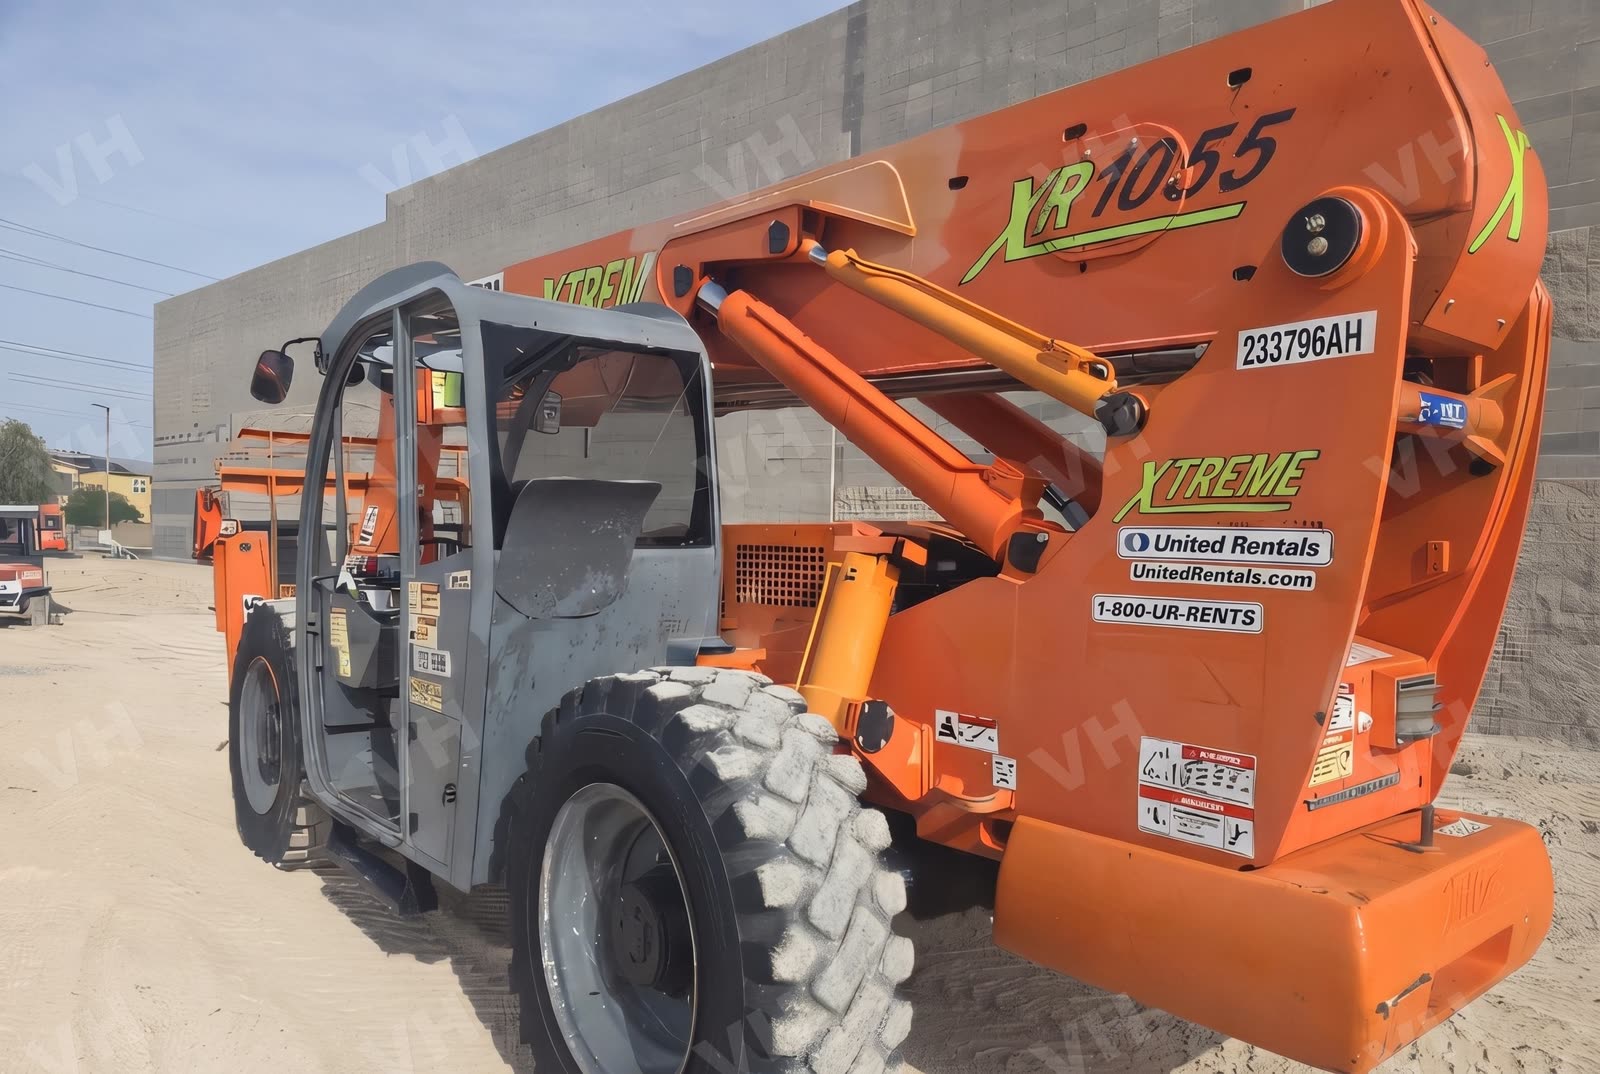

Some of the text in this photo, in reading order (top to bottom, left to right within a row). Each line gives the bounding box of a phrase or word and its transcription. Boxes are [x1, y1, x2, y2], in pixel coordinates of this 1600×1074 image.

[1243, 318, 1362, 366] 233796AH
[1112, 450, 1321, 524] XTREME
[1154, 534, 1321, 557] United Rentals
[1133, 564, 1313, 588] UnitedRentals.com
[1097, 601, 1256, 626] 1-800-UR-RENTS
